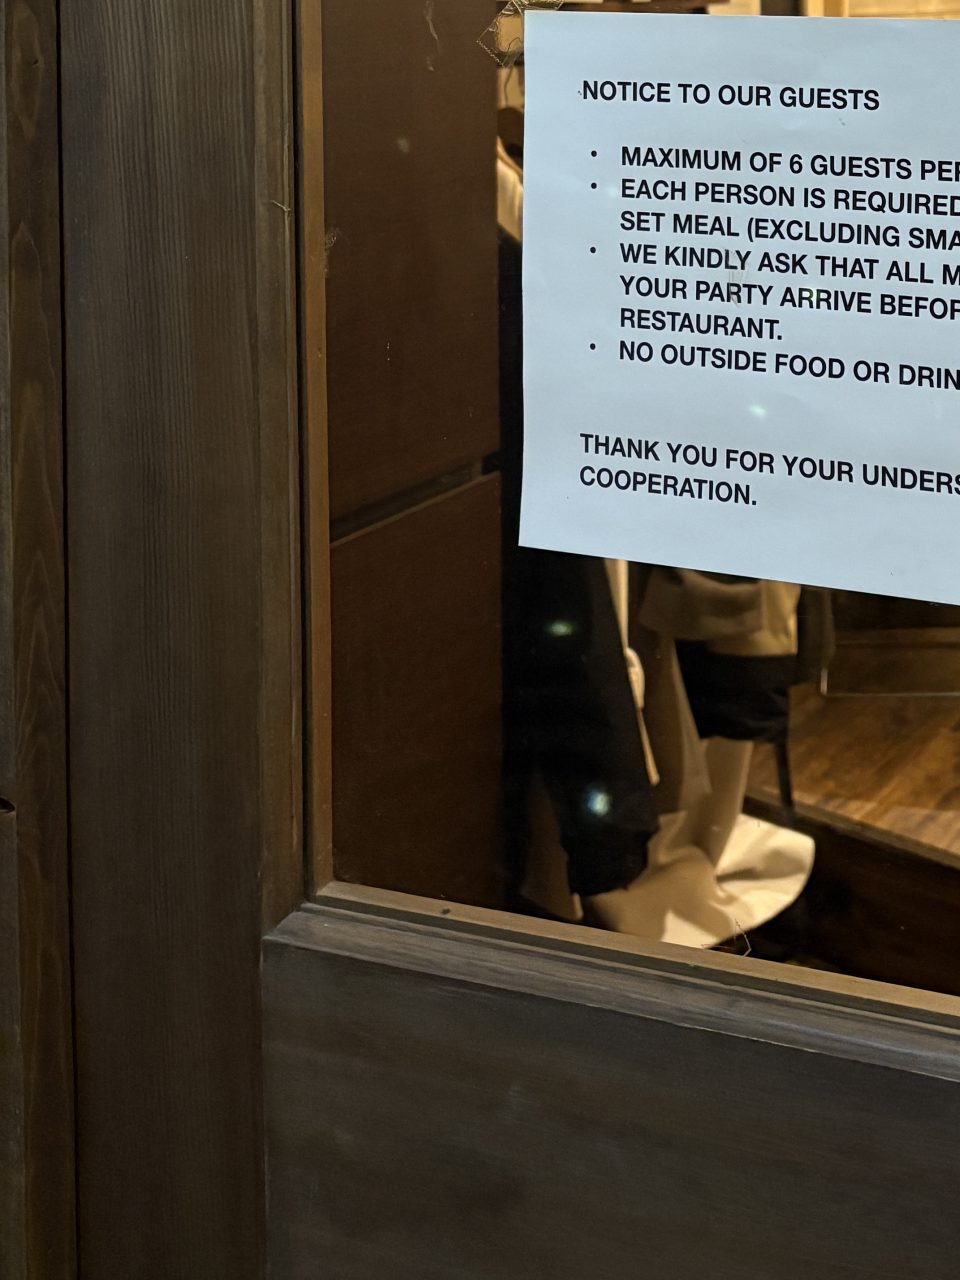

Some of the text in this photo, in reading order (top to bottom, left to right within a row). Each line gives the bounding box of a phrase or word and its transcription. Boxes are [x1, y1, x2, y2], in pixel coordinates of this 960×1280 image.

[583, 80, 880, 111] NOTICE TO OUR GUESTS
[621, 146, 741, 172] MAXIMUM
[749, 151, 783, 173] OF
[789, 153, 803, 175] 6
[810, 154, 912, 180] GUESTS
[621, 178, 687, 201] EACH
[694, 181, 795, 207] PERSON
[803, 187, 826, 209] IS
[620, 210, 666, 233] SET
[673, 213, 740, 237] MEAL
[747, 217, 900, 248] (EXCLUDING
[619, 242, 657, 265] WE
[664, 245, 752, 271] KINDLY
[757, 251, 809, 275] ASK
[814, 255, 880, 280] THAT
[885, 260, 934, 284] ALL
[619, 275, 688, 300] YOUR
[695, 280, 774, 306] PARTY
[779, 286, 872, 314] ARRIVE
[620, 307, 785, 341] RESTAURANT.
[619, 340, 654, 363] NO
[660, 343, 767, 373] OUTSIDE
[774, 353, 846, 379] FOOD
[853, 360, 890, 384] OR
[579, 432, 660, 462] THANK
[666, 442, 718, 468] YOU
[725, 448, 775, 474] FOR
[781, 454, 854, 483] YOUR
[579, 465, 755, 506] COOPERATION.
